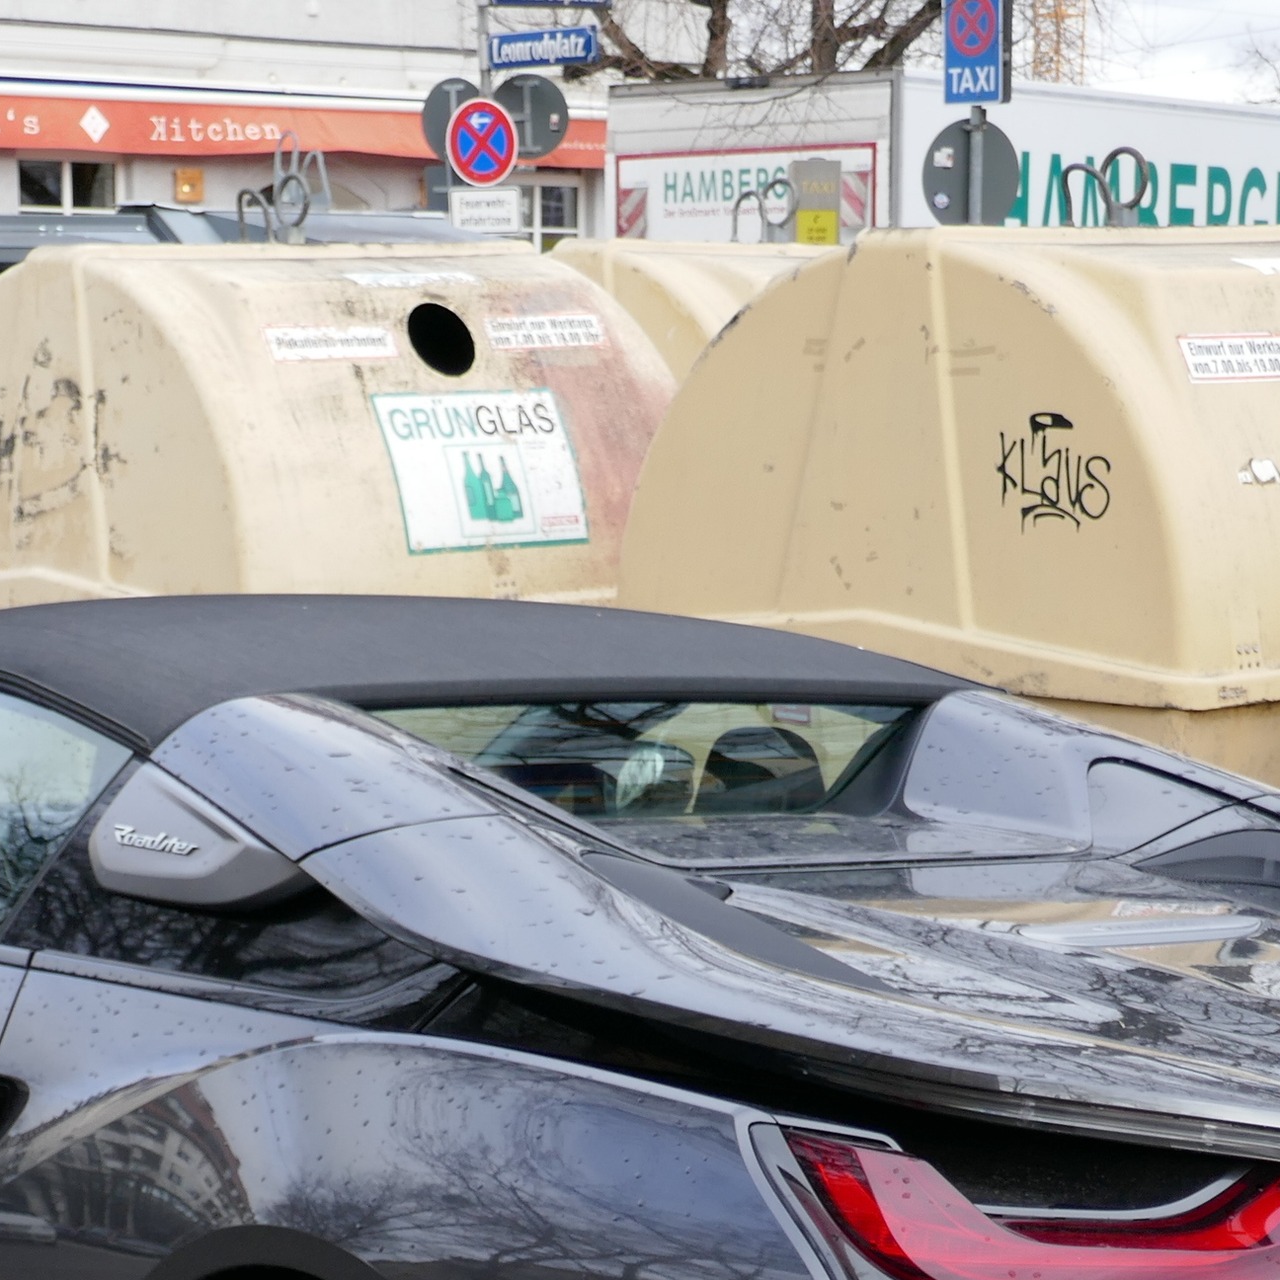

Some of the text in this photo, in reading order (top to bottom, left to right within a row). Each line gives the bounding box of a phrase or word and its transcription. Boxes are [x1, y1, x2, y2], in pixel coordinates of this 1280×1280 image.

[491, 31, 587, 64] Leonrodplatz
[948, 66, 997, 95] TAXI
[149, 114, 283, 142] Kitchen
[663, 165, 788, 205] HAMBERG
[1187, 340, 1227, 356] Einwurf
[1227, 343, 1245, 356] nur
[388, 399, 556, 441] GRÜNGLAS
[114, 824, 200, 857] Roadster
